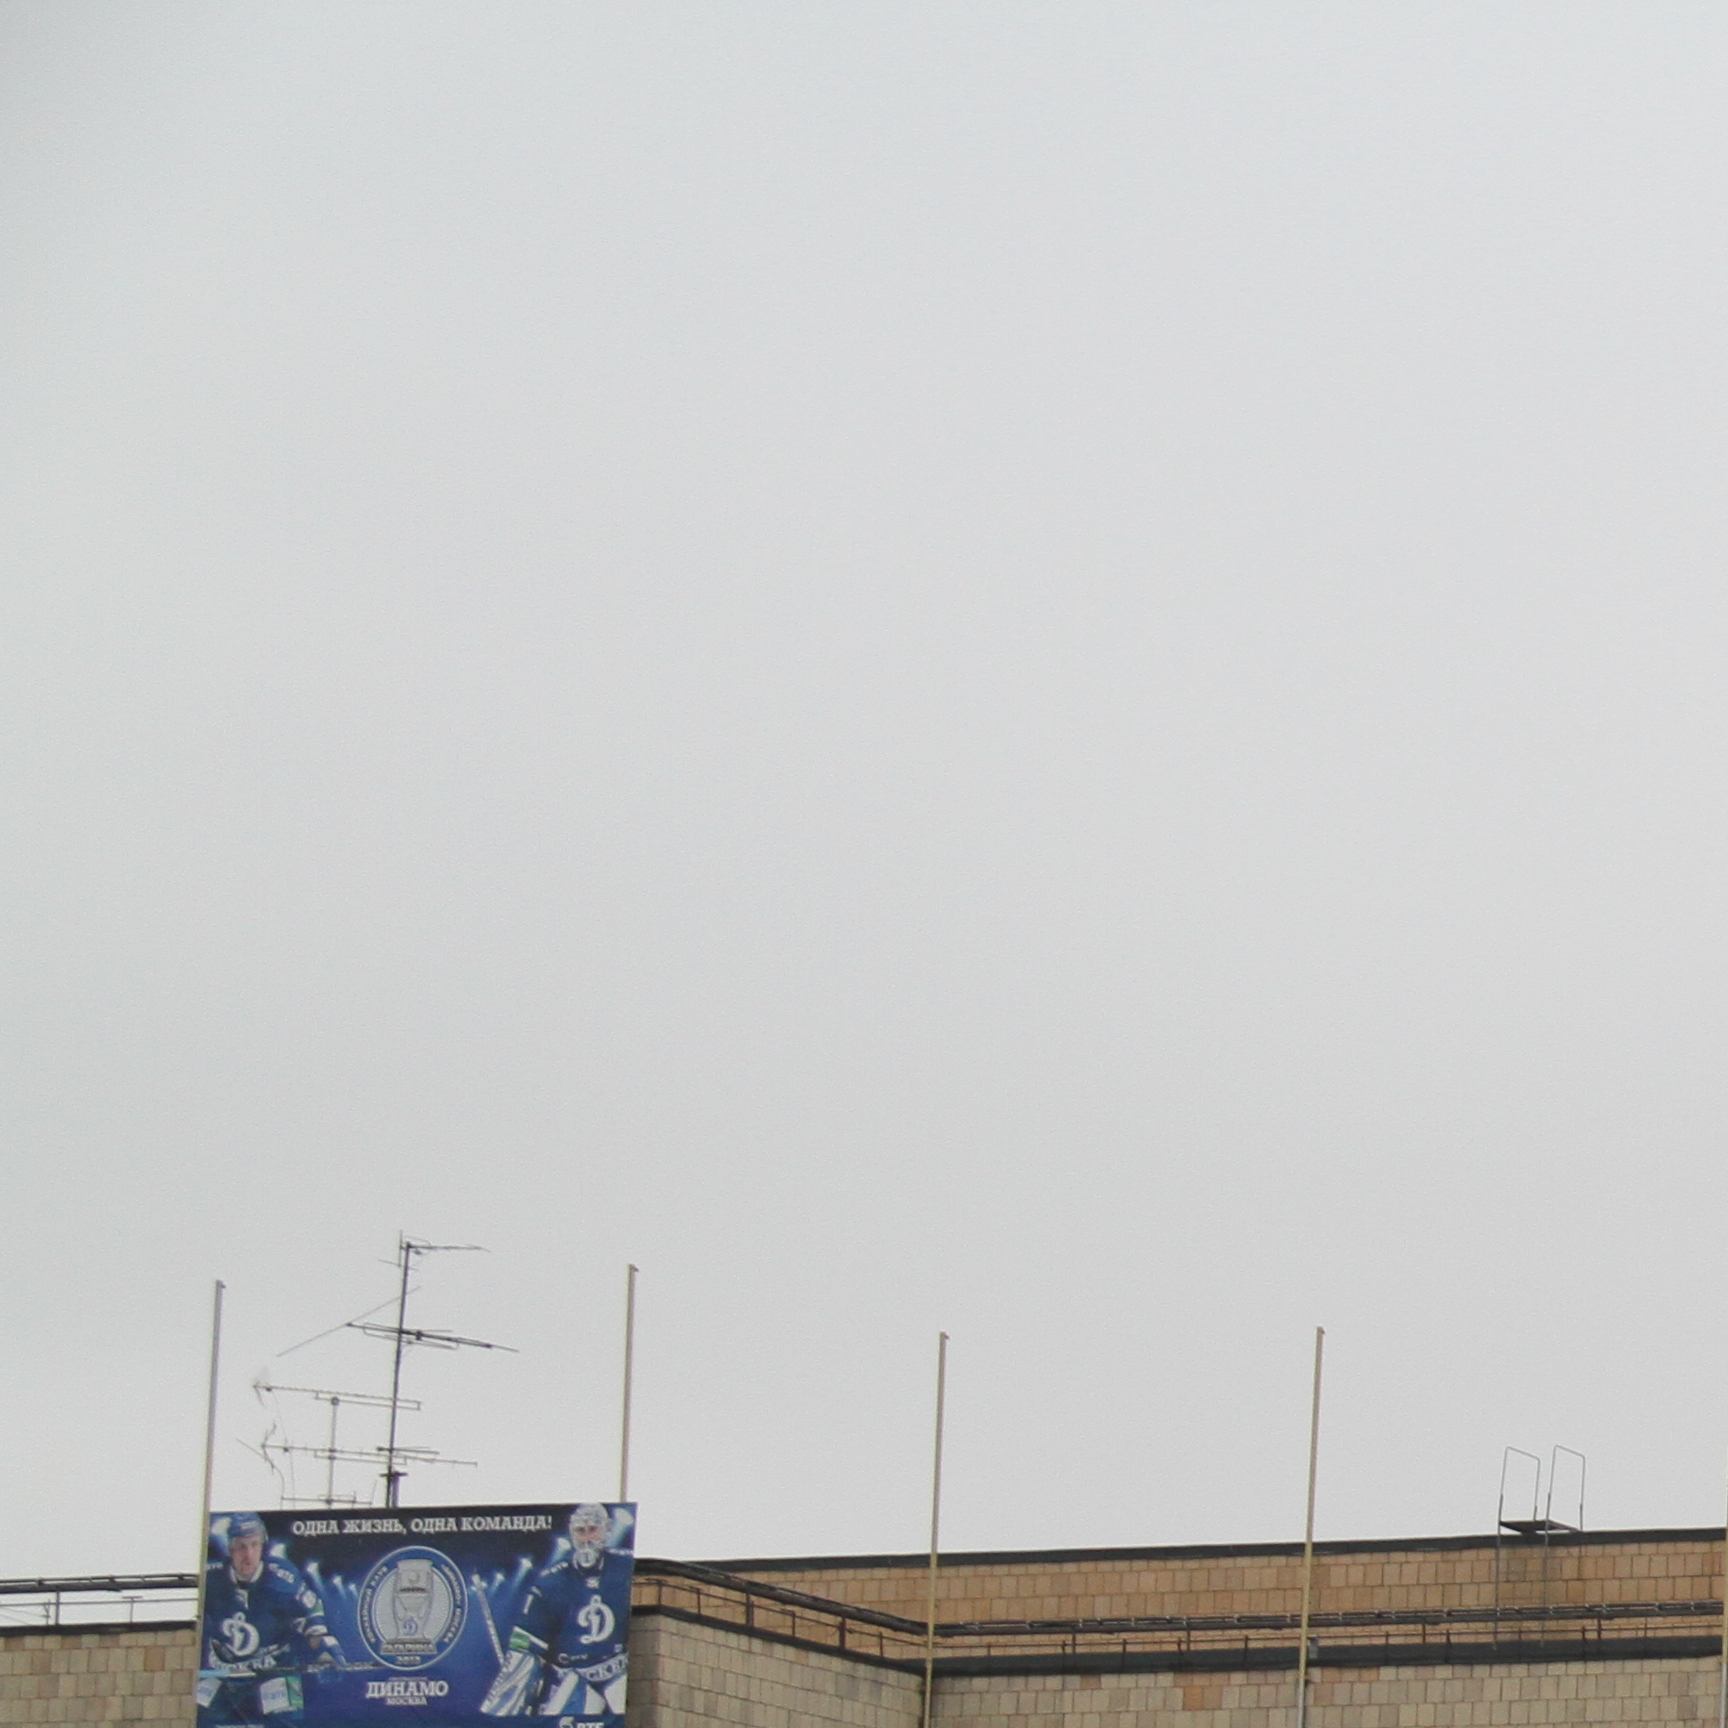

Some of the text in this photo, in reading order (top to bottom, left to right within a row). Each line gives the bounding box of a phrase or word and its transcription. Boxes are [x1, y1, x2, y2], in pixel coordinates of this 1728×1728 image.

[292, 1515, 552, 1536] ОДНА ЖИЗНЬ, ОДНА КОМАНДА!
[365, 1680, 449, 1698] ДИНАМО
